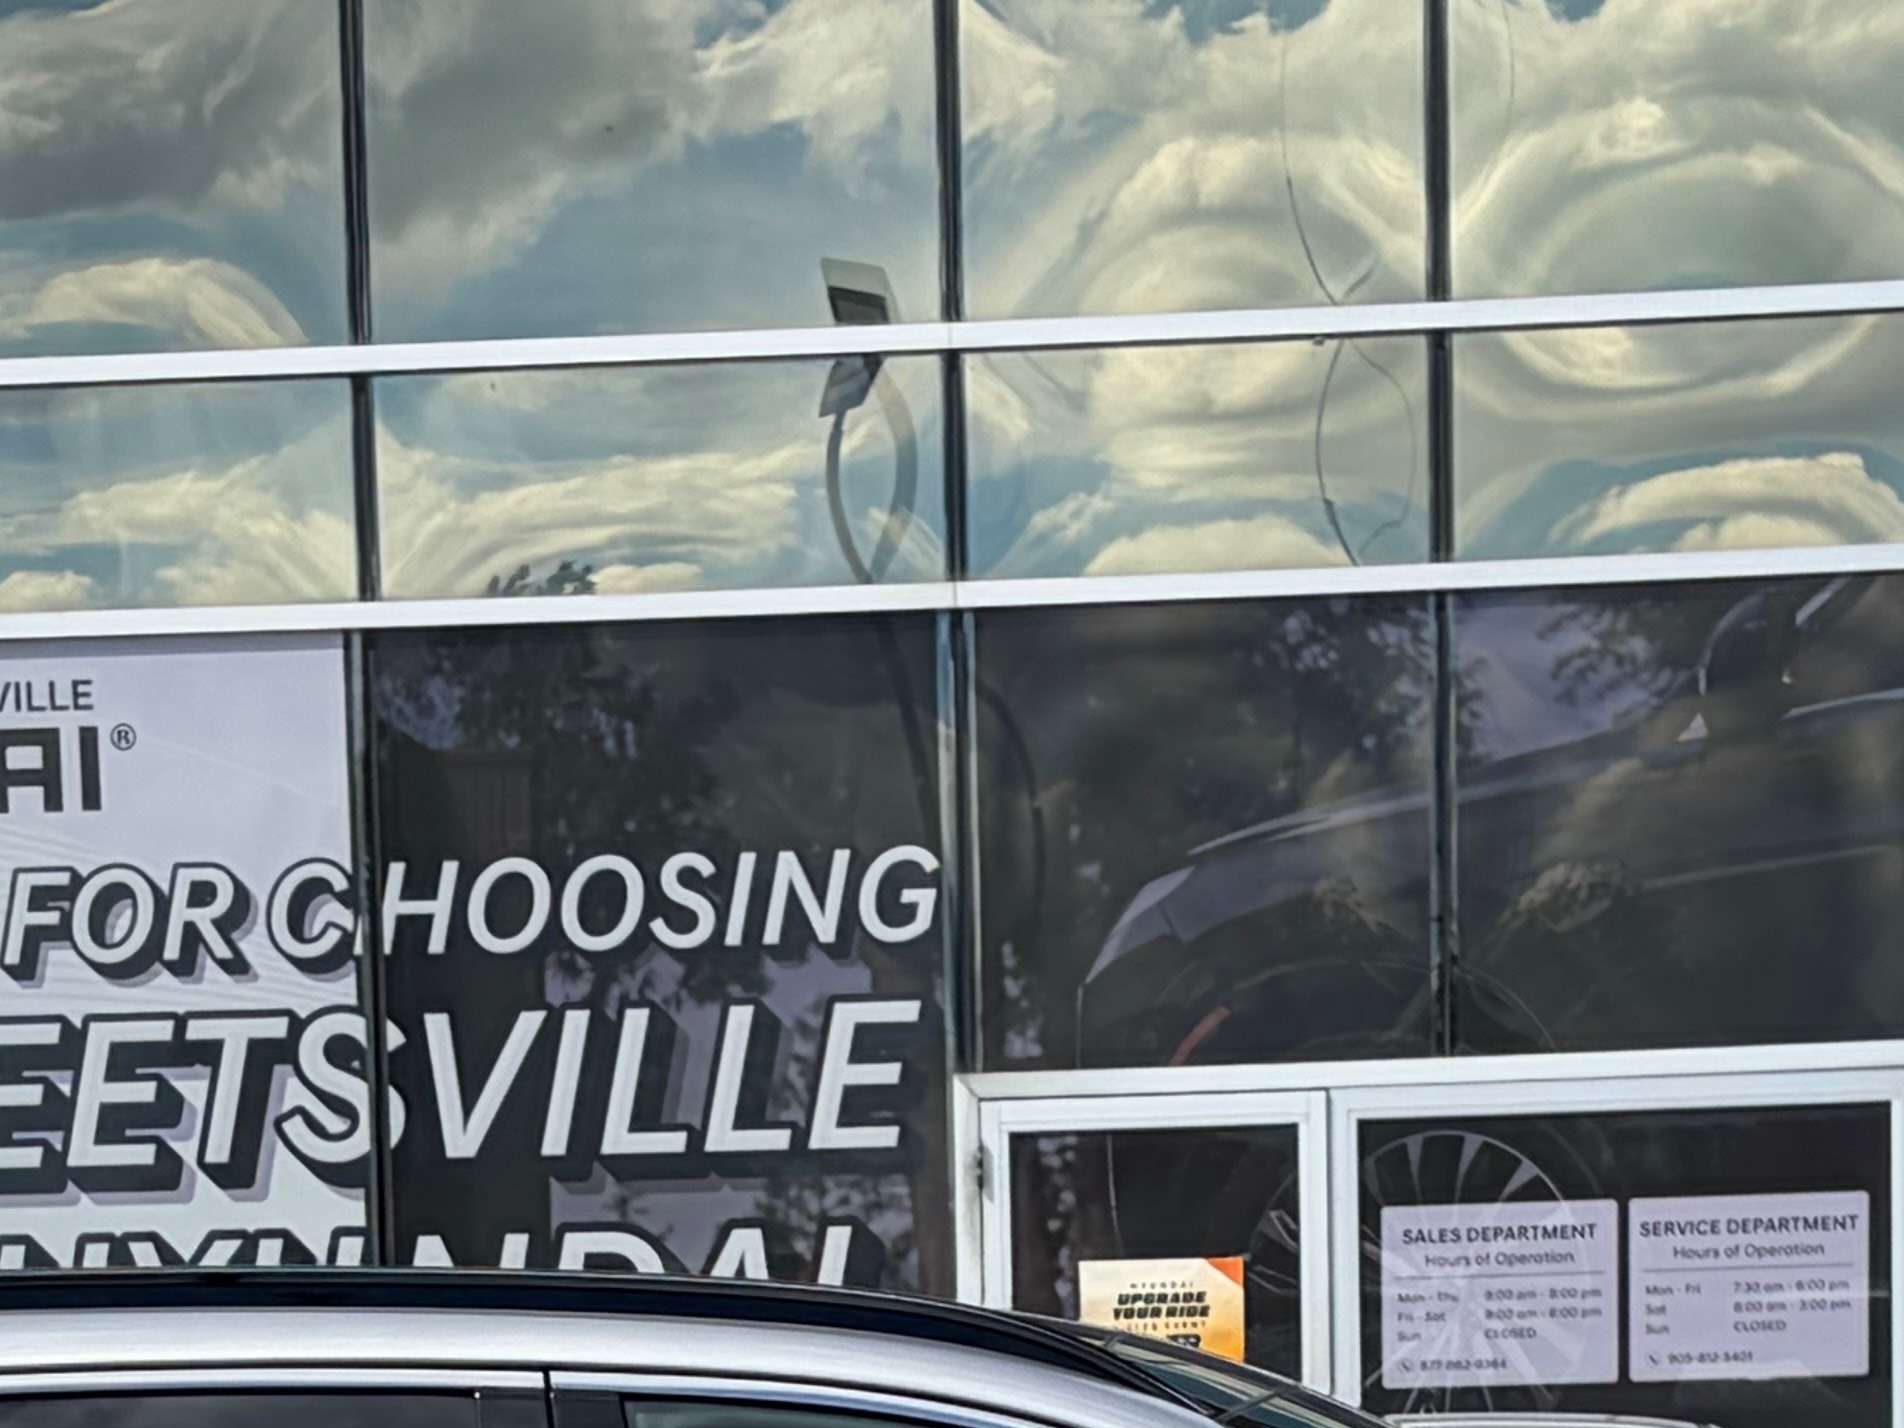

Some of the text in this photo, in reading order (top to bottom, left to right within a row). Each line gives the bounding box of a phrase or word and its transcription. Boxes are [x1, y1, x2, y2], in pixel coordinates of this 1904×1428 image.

[0, 860, 258, 988] FOR
[268, 844, 942, 978] CHOOSING
[1402, 1222, 1598, 1245] SALES DEPARTMENT
[1639, 1214, 1859, 1238] SERVICE DEPARTMENT
[1425, 1251, 1576, 1268] Hours of Operation
[1673, 1242, 1825, 1260] Hours of Operation
[1117, 1291, 1207, 1306] UPGRADE
[1113, 1305, 1211, 1321] YOUR RIDE
[1484, 1326, 1537, 1341] CLOSED
[1733, 1319, 1787, 1333] CLOSED
